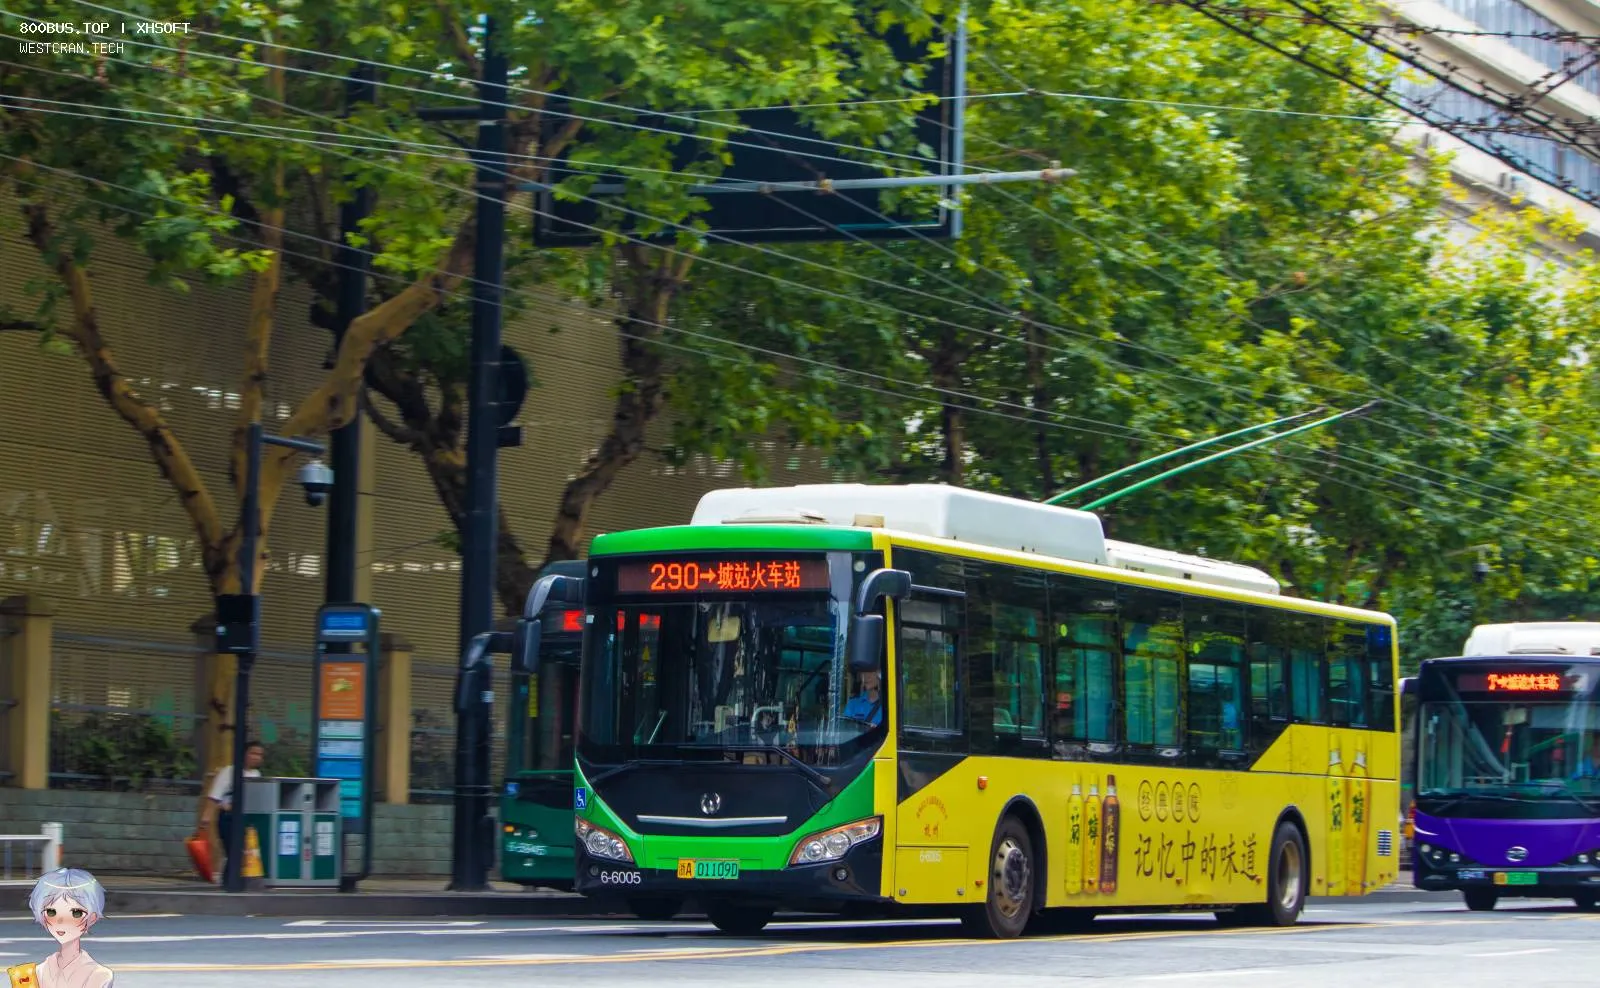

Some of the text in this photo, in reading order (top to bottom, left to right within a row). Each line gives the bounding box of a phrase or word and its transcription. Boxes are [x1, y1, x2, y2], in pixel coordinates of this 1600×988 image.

[650, 560, 801, 591] 290 城站火车站
[1134, 829, 1259, 885] 记忆中的味道
[600, 870, 641, 884] 6-6005
